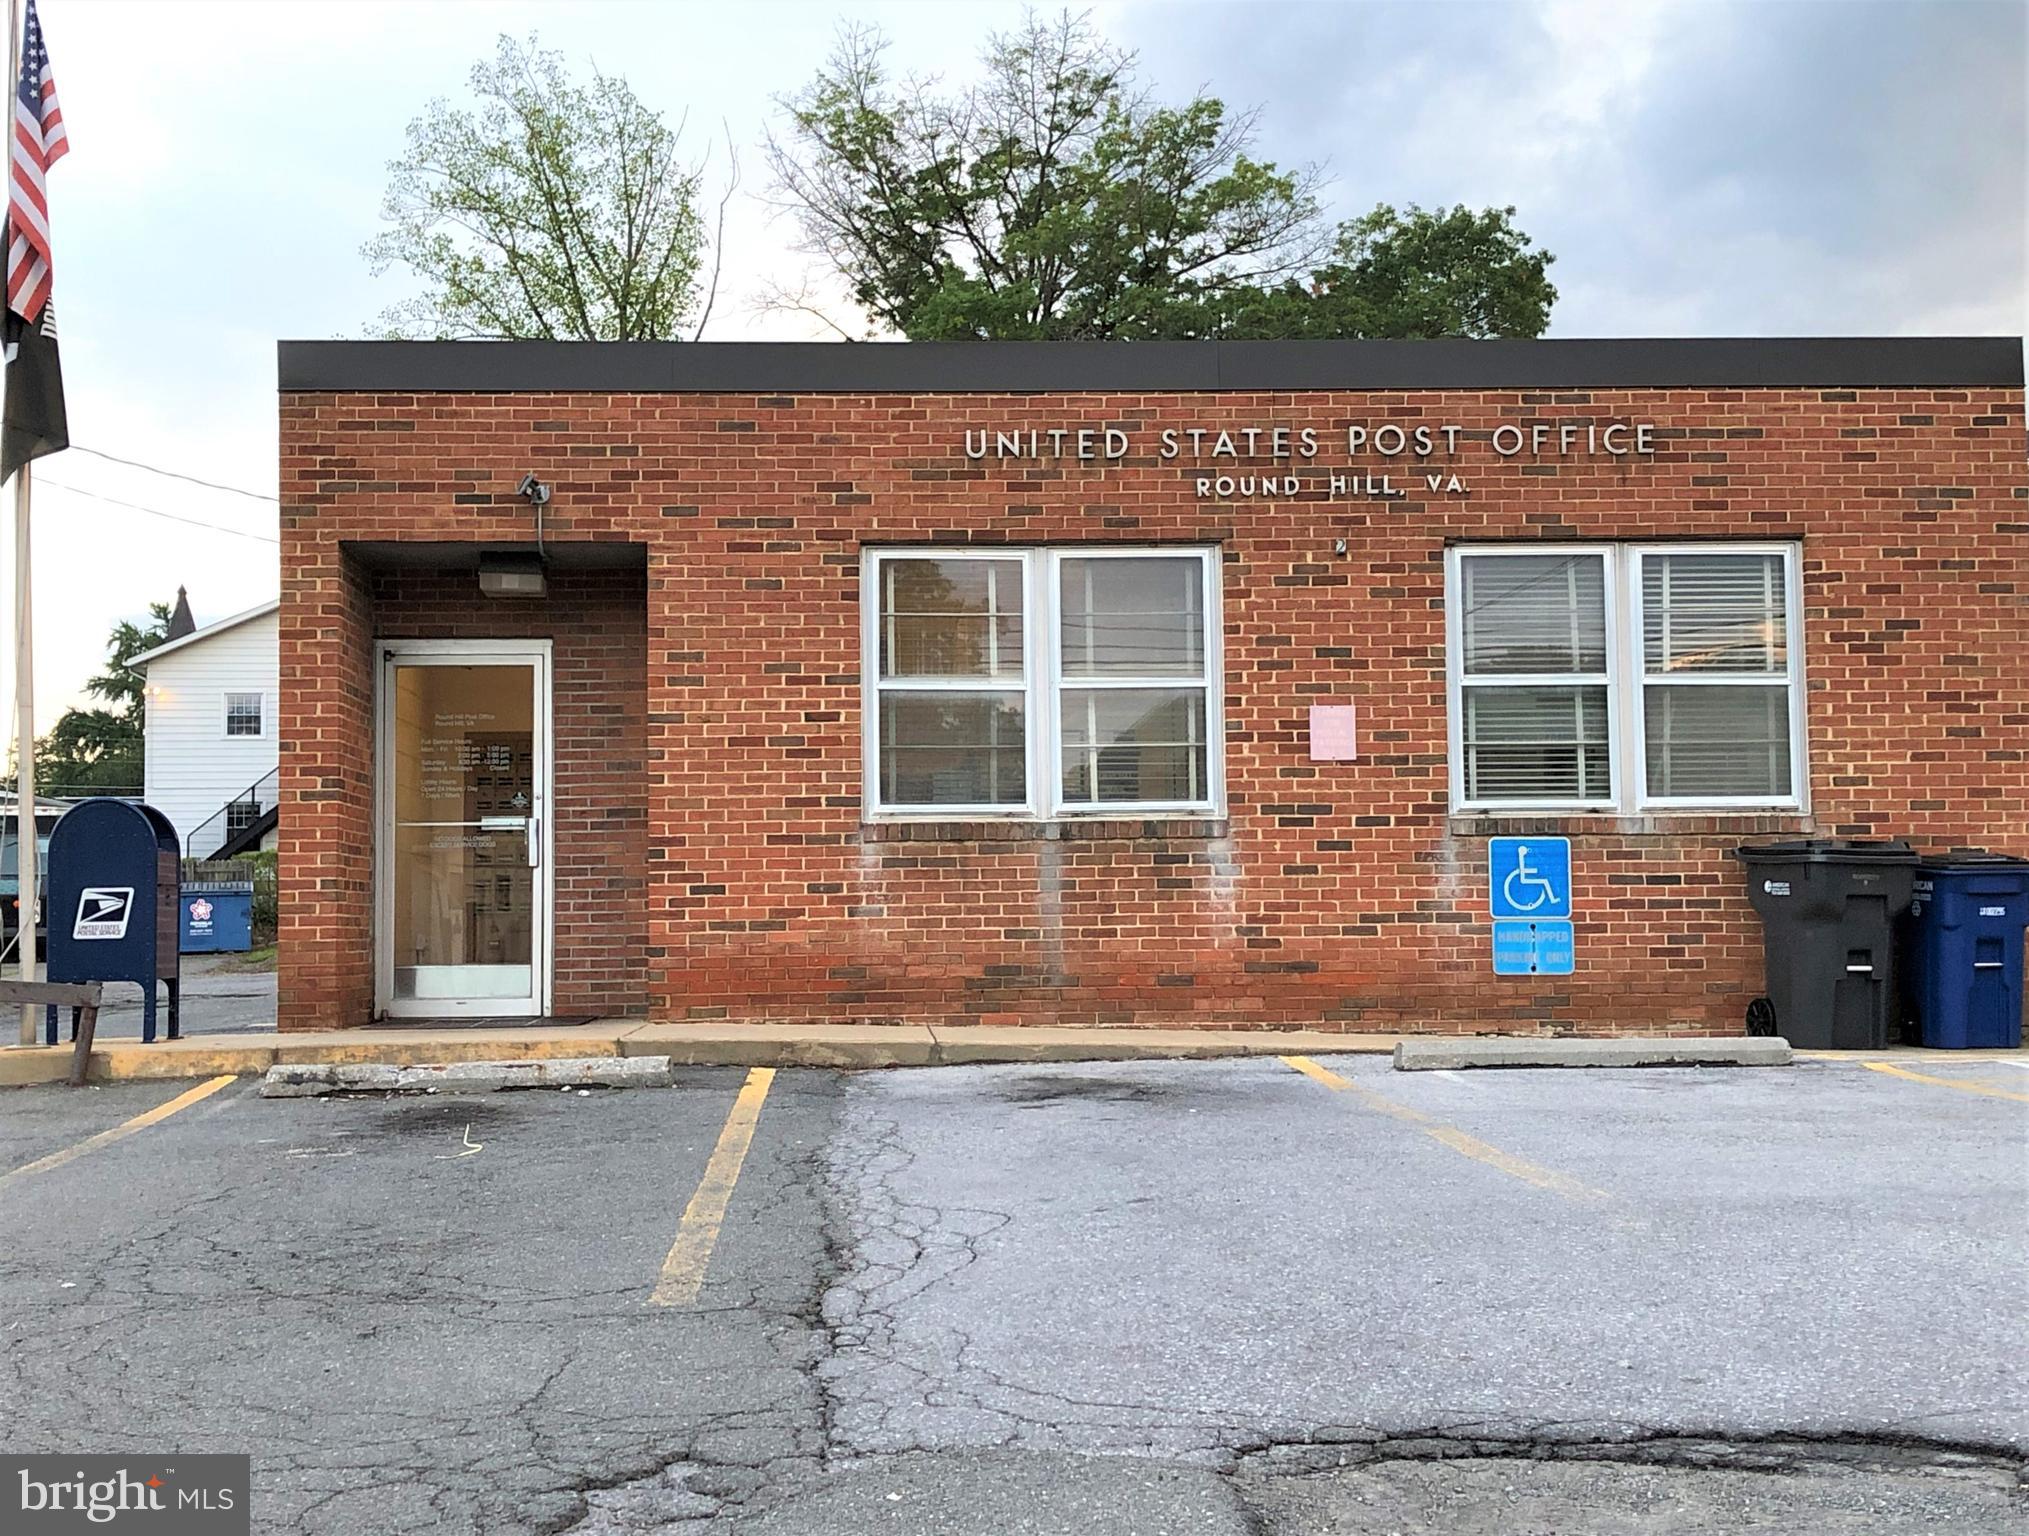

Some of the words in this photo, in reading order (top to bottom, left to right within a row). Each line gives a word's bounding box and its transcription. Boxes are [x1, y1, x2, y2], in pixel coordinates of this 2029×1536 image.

[965, 428, 1130, 461] UNITED
[1160, 427, 1320, 459] STATES
[1348, 424, 1464, 457] POST
[1491, 423, 1657, 457] OFFICE
[1196, 475, 1301, 498] ROUND
[1329, 474, 1406, 498] HILL,
[1426, 474, 1472, 495] VA.
[1546, 952, 1571, 963] ONLY
